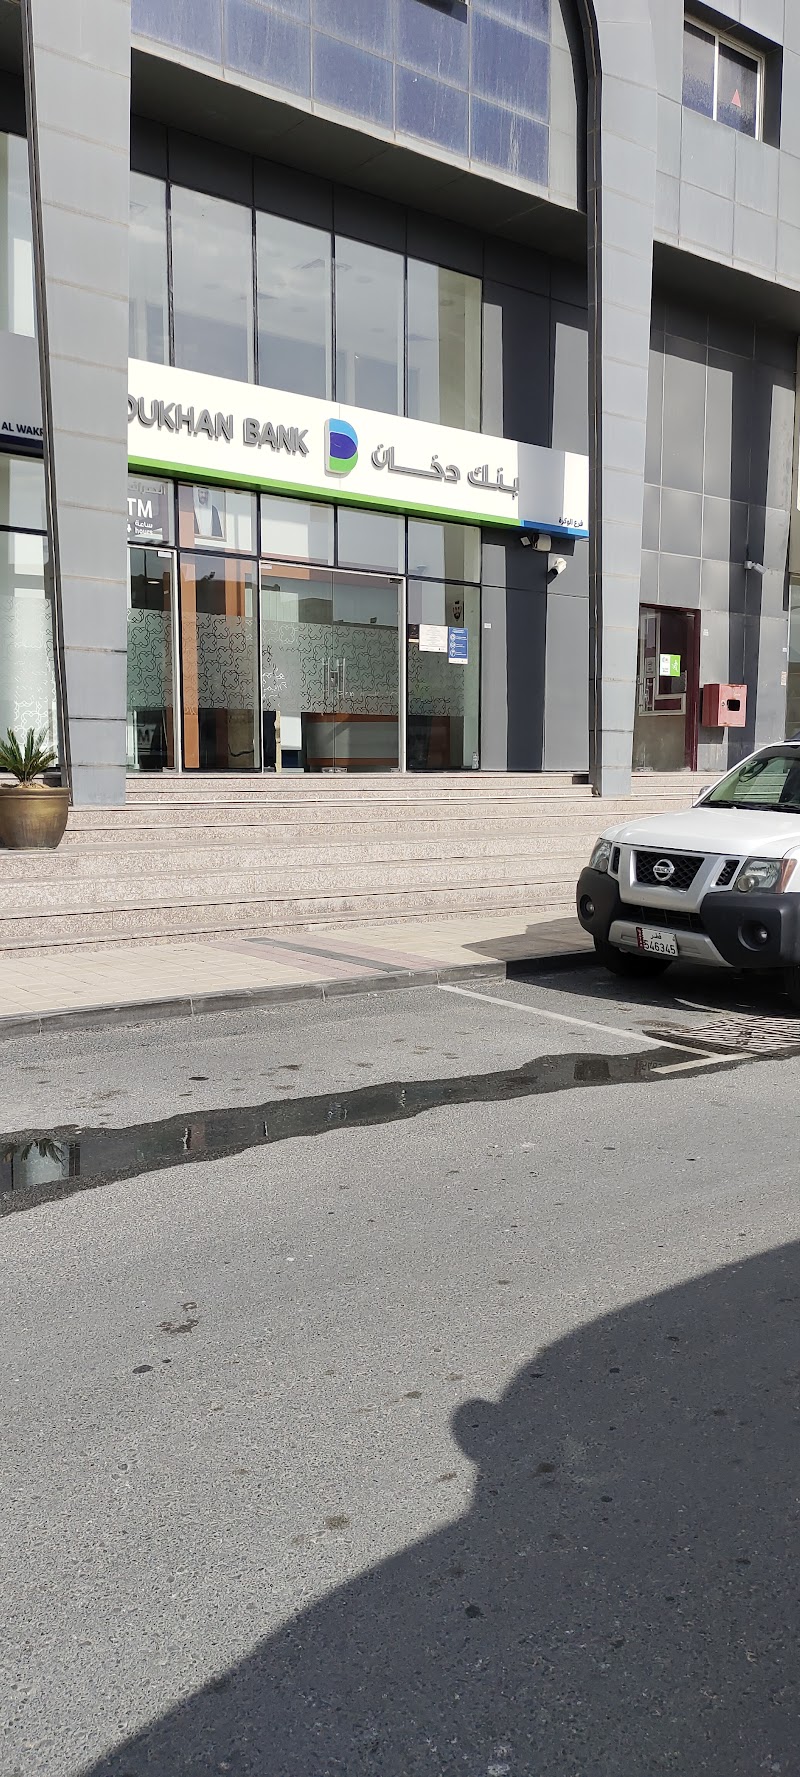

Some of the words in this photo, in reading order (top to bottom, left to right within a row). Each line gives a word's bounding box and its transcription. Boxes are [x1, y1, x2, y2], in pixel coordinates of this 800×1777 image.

[1, 421, 15, 432] AL
[243, 417, 310, 456] BANK
[467, 464, 519, 500] بنك
[650, 932, 662, 940] قطر
[643, 939, 676, 954] 546345
